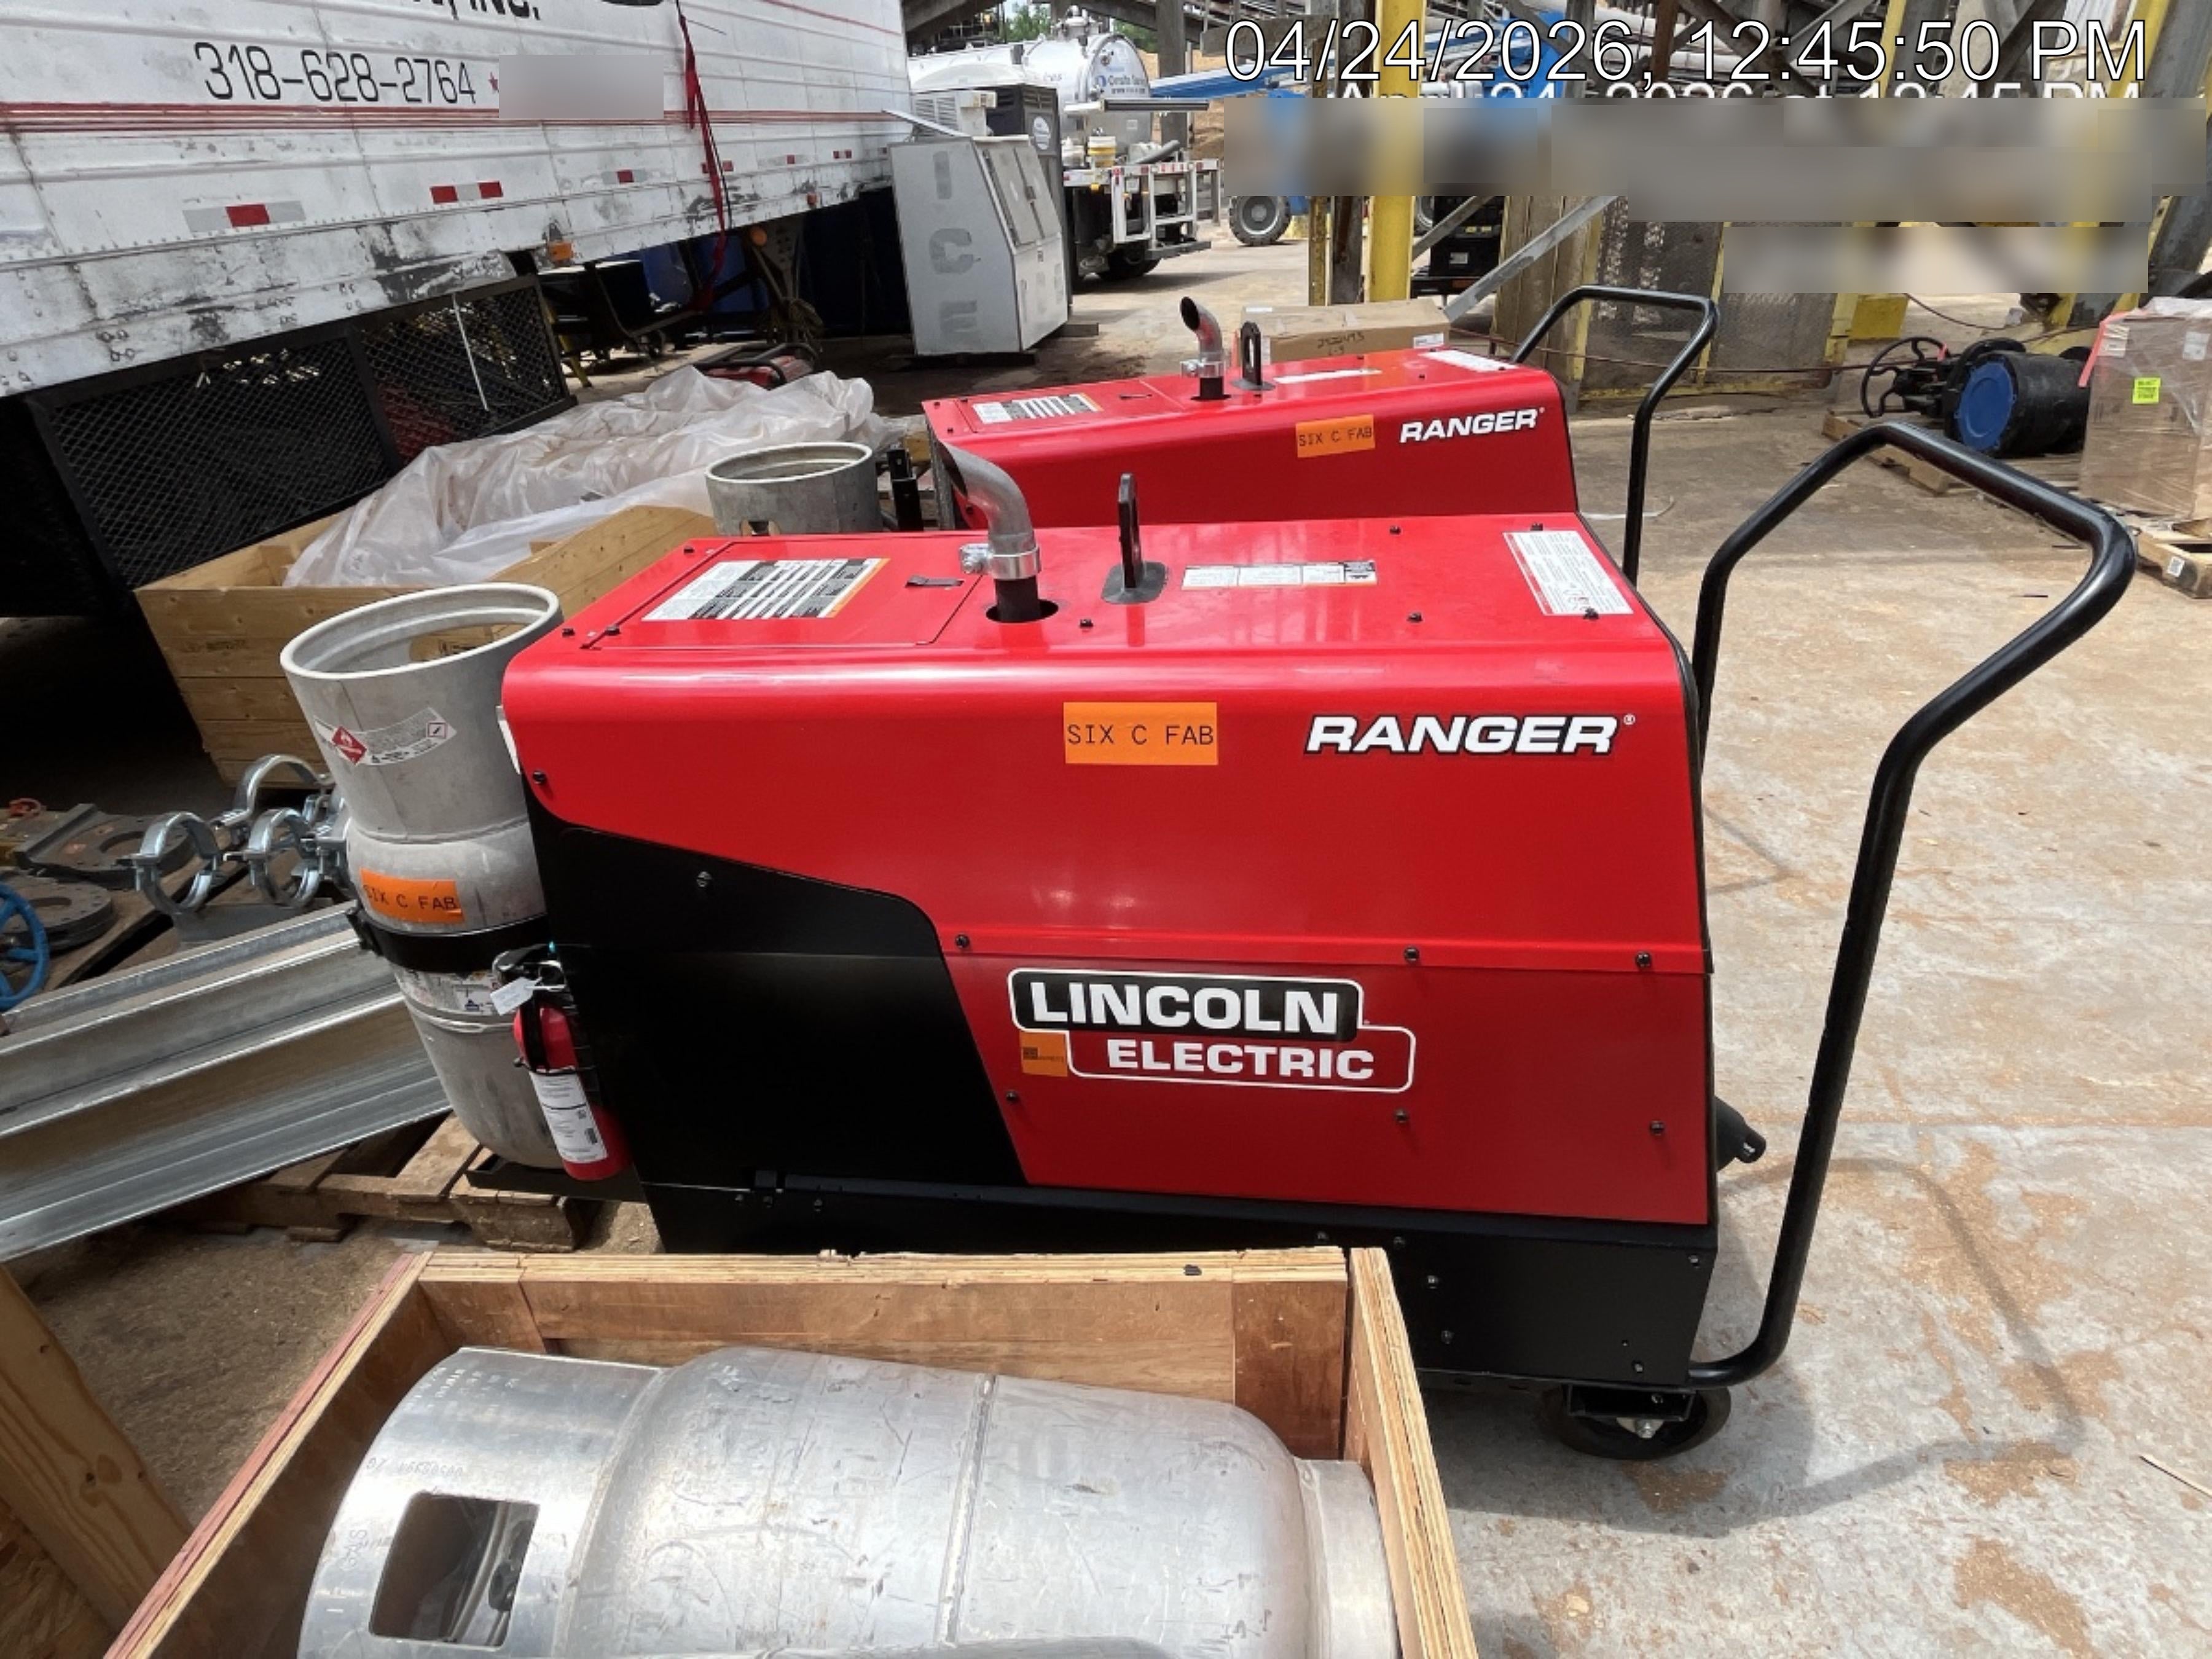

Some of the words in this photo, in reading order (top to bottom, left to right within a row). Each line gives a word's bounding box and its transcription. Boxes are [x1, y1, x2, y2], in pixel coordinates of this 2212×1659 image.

[194, 41, 476, 103] 318-628-2764
[1299, 433, 1322, 447] SIX
[1330, 430, 1340, 442] C
[1348, 426, 1372, 440] FAB
[1399, 408, 1538, 443] RANGER
[1067, 724, 1114, 745] SIX
[1131, 724, 1147, 745] C
[1166, 725, 1214, 745] FAB
[1305, 715, 1618, 754] RANGER
[363, 884, 389, 905] SIX
[396, 894, 408, 908] C
[418, 895, 458, 911] FAB
[1030, 981, 1338, 1033] LINCOLN
[1107, 1038, 1374, 1080] ELECTRIC
